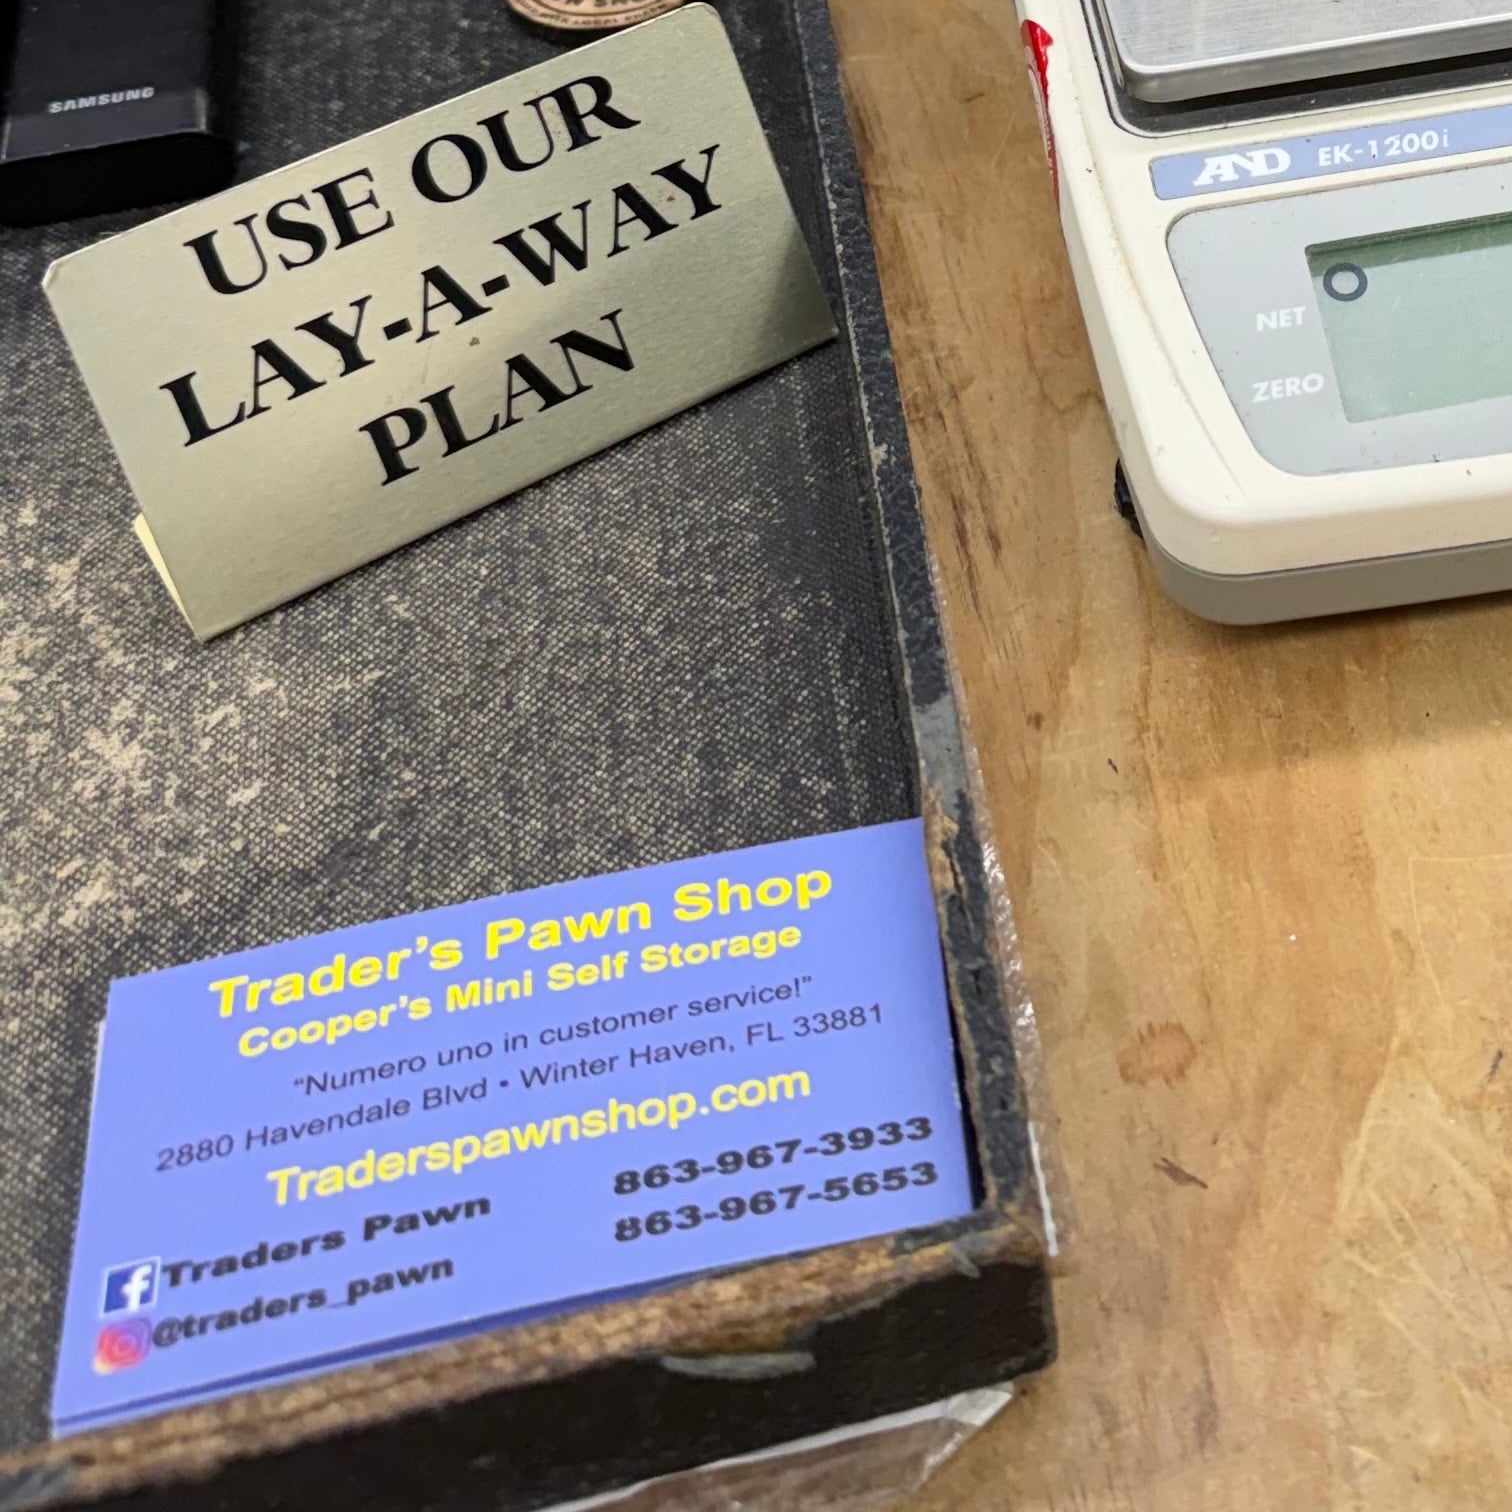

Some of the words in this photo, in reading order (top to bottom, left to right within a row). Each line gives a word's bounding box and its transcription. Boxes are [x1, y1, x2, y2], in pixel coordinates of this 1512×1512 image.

[48, 86, 155, 113] SAMSUNG
[183, 167, 395, 295] USE
[411, 74, 641, 205] OUR
[1318, 128, 1449, 167] EK-1200i
[159, 144, 723, 448] LAY-A-WAY
[1256, 306, 1307, 331] NET
[358, 308, 635, 487] PLAN
[1252, 373, 1324, 403] ZERO
[209, 936, 463, 1018] Trader’s
[485, 902, 651, 959] Pawn
[673, 869, 832, 921] Shop
[238, 996, 431, 1056] Cooper’s
[446, 969, 532, 1012] Mini
[547, 951, 628, 991] Self
[640, 925, 802, 973] Storage
[437, 1042, 493, 1066] uno
[503, 1032, 529, 1054] in
[539, 1005, 678, 1046] customer
[155, 1134, 235, 1172] 2880
[245, 1097, 411, 1150] Havendale
[423, 1078, 488, 1111] Blvd
[520, 1050, 619, 1089] Winter
[630, 1031, 736, 1069] Haven,
[746, 1021, 784, 1051] FL
[793, 1002, 883, 1037] 33881
[266, 1070, 811, 1206] Traderspawnshop.com
[614, 1116, 933, 1194] 863-967-3933
[162, 1229, 347, 1287] Traders
[363, 1196, 492, 1242] Pawn
[615, 1161, 938, 1242] 863-967-5653
[151, 1257, 454, 1348] @traders_pawn
